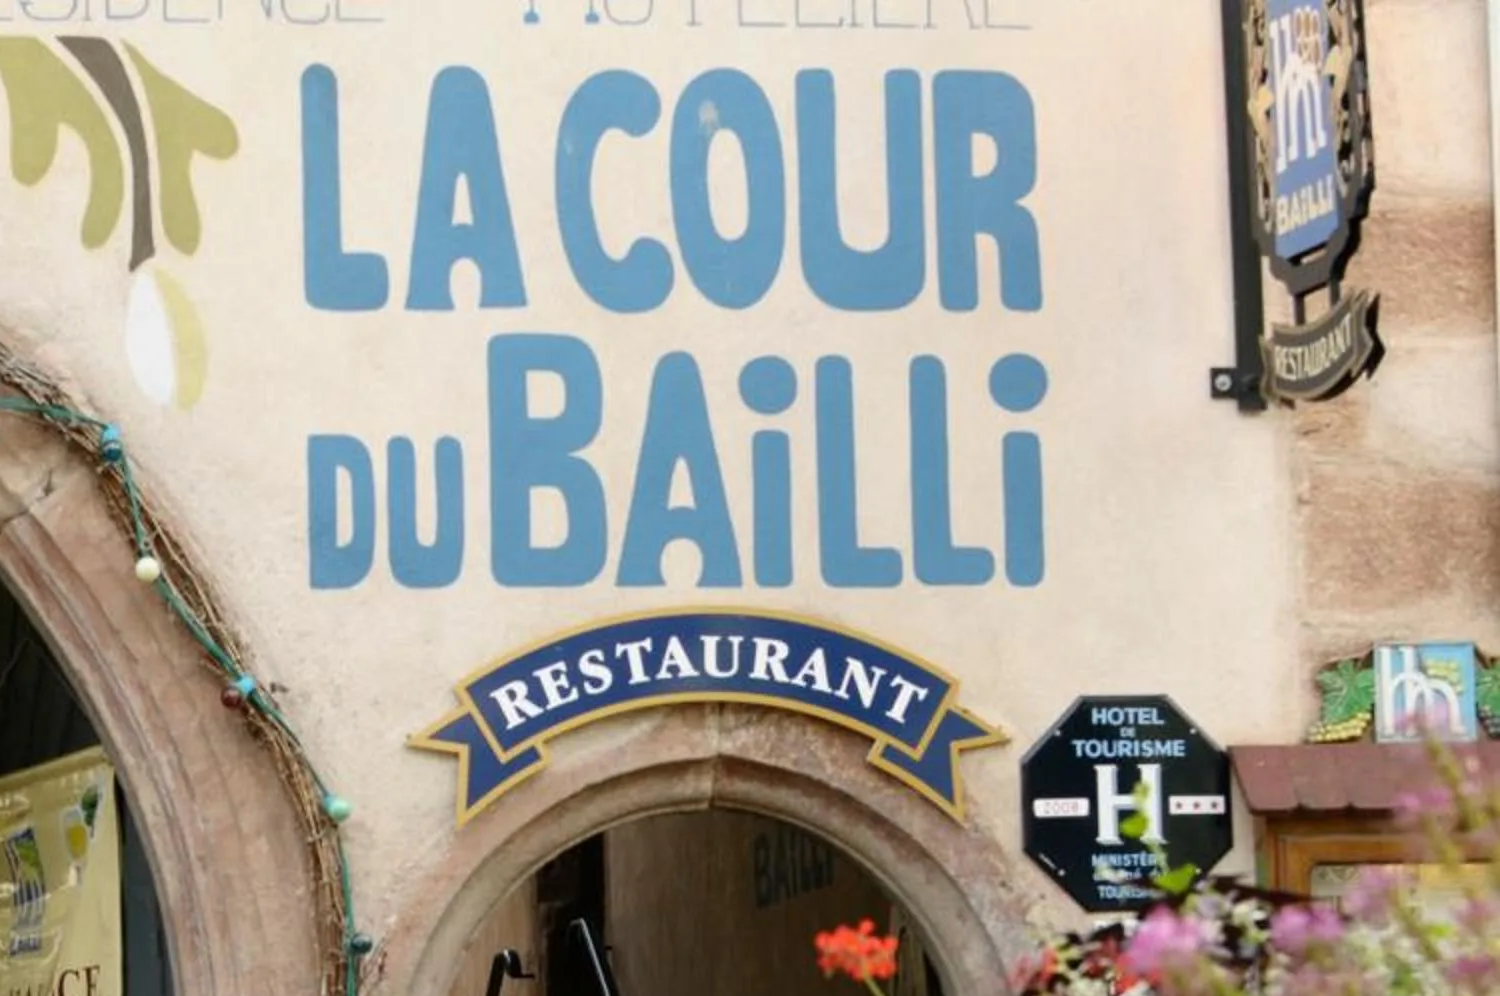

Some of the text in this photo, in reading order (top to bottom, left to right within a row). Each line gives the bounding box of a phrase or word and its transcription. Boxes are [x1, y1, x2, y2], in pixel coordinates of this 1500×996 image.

[301, 62, 1043, 313] LA COUR
[1275, 313, 1351, 380] RESTAURANT
[308, 434, 464, 591] DU
[488, 635, 928, 729] RESTAURANT
[1091, 707, 1165, 725] HOTEL
[1071, 740, 1186, 757] TOURISME
[1094, 764, 1168, 845] H
